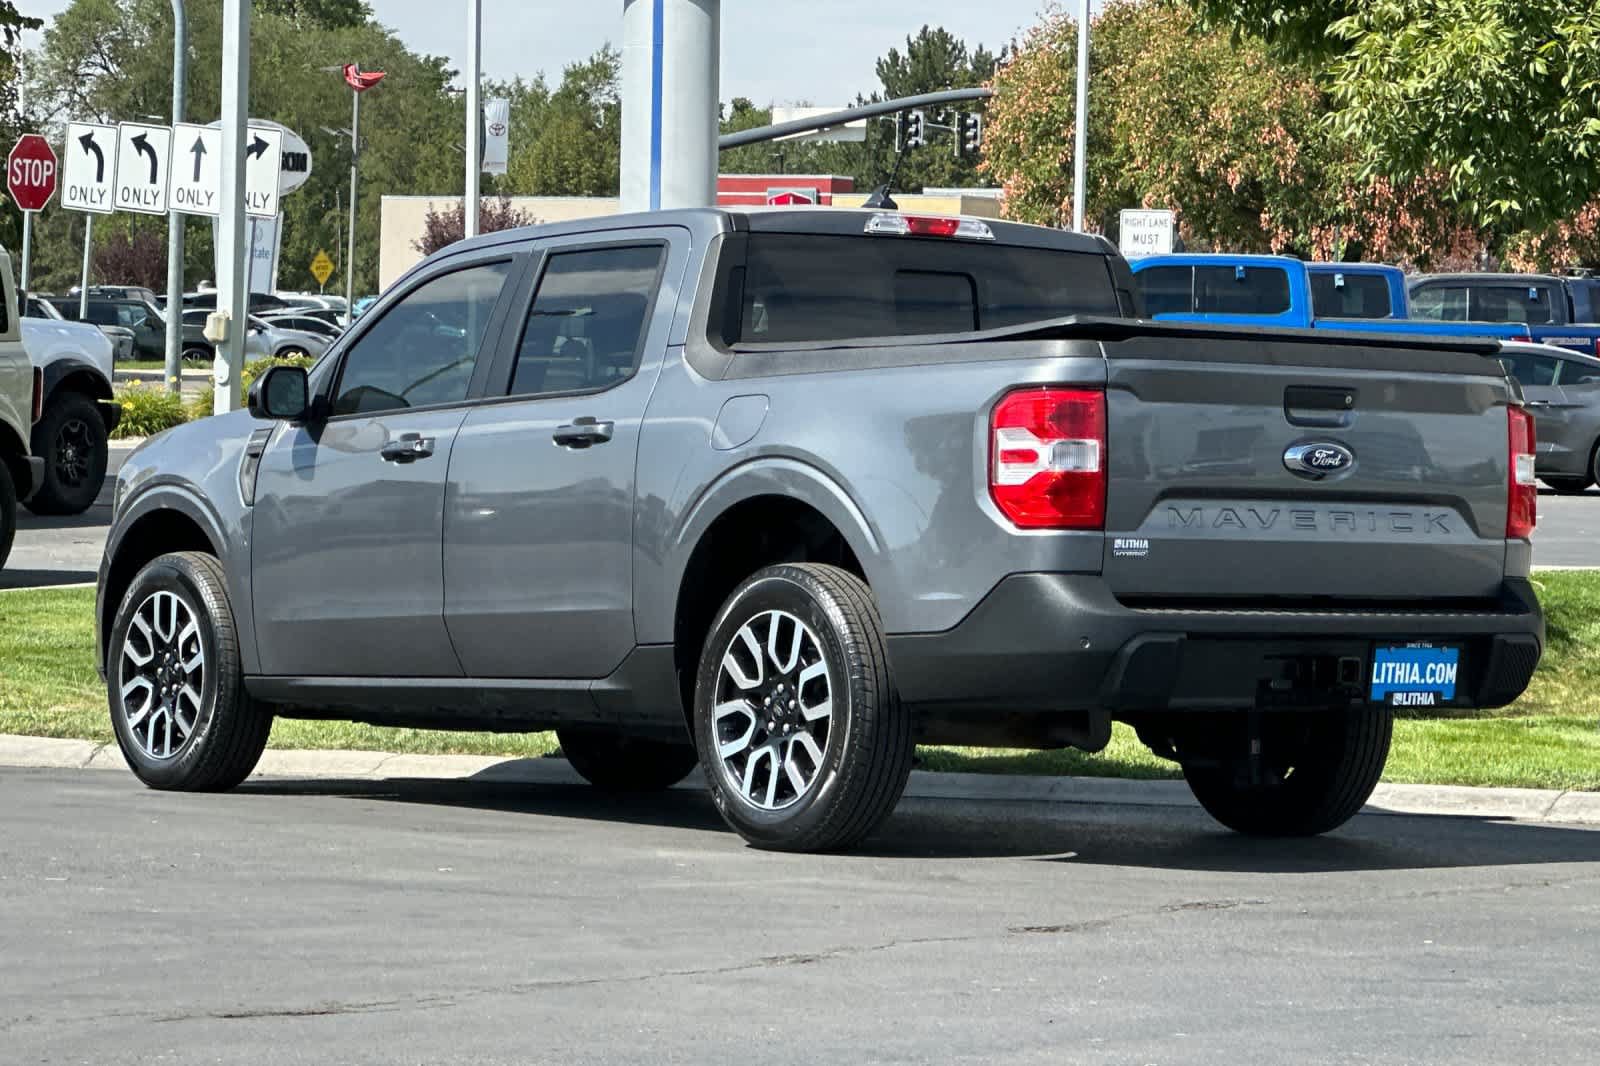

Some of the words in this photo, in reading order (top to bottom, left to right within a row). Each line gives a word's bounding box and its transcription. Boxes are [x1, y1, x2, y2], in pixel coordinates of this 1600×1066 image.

[12, 158, 53, 187] STOP
[69, 185, 106, 205] ONLY
[121, 186, 160, 206] ONLY
[176, 187, 214, 208] ONLY
[245, 191, 270, 209] NLY
[1125, 217, 1146, 228] RIGHT
[1149, 217, 1169, 228] LANE
[1132, 233, 1159, 245] MUST
[1312, 449, 1342, 466] Ford
[1167, 507, 1450, 534] MAVERICK
[1121, 539, 1149, 548] LITHIA
[1372, 662, 1457, 684] LITHIA.COM
[1402, 692, 1435, 705] LITHIA
